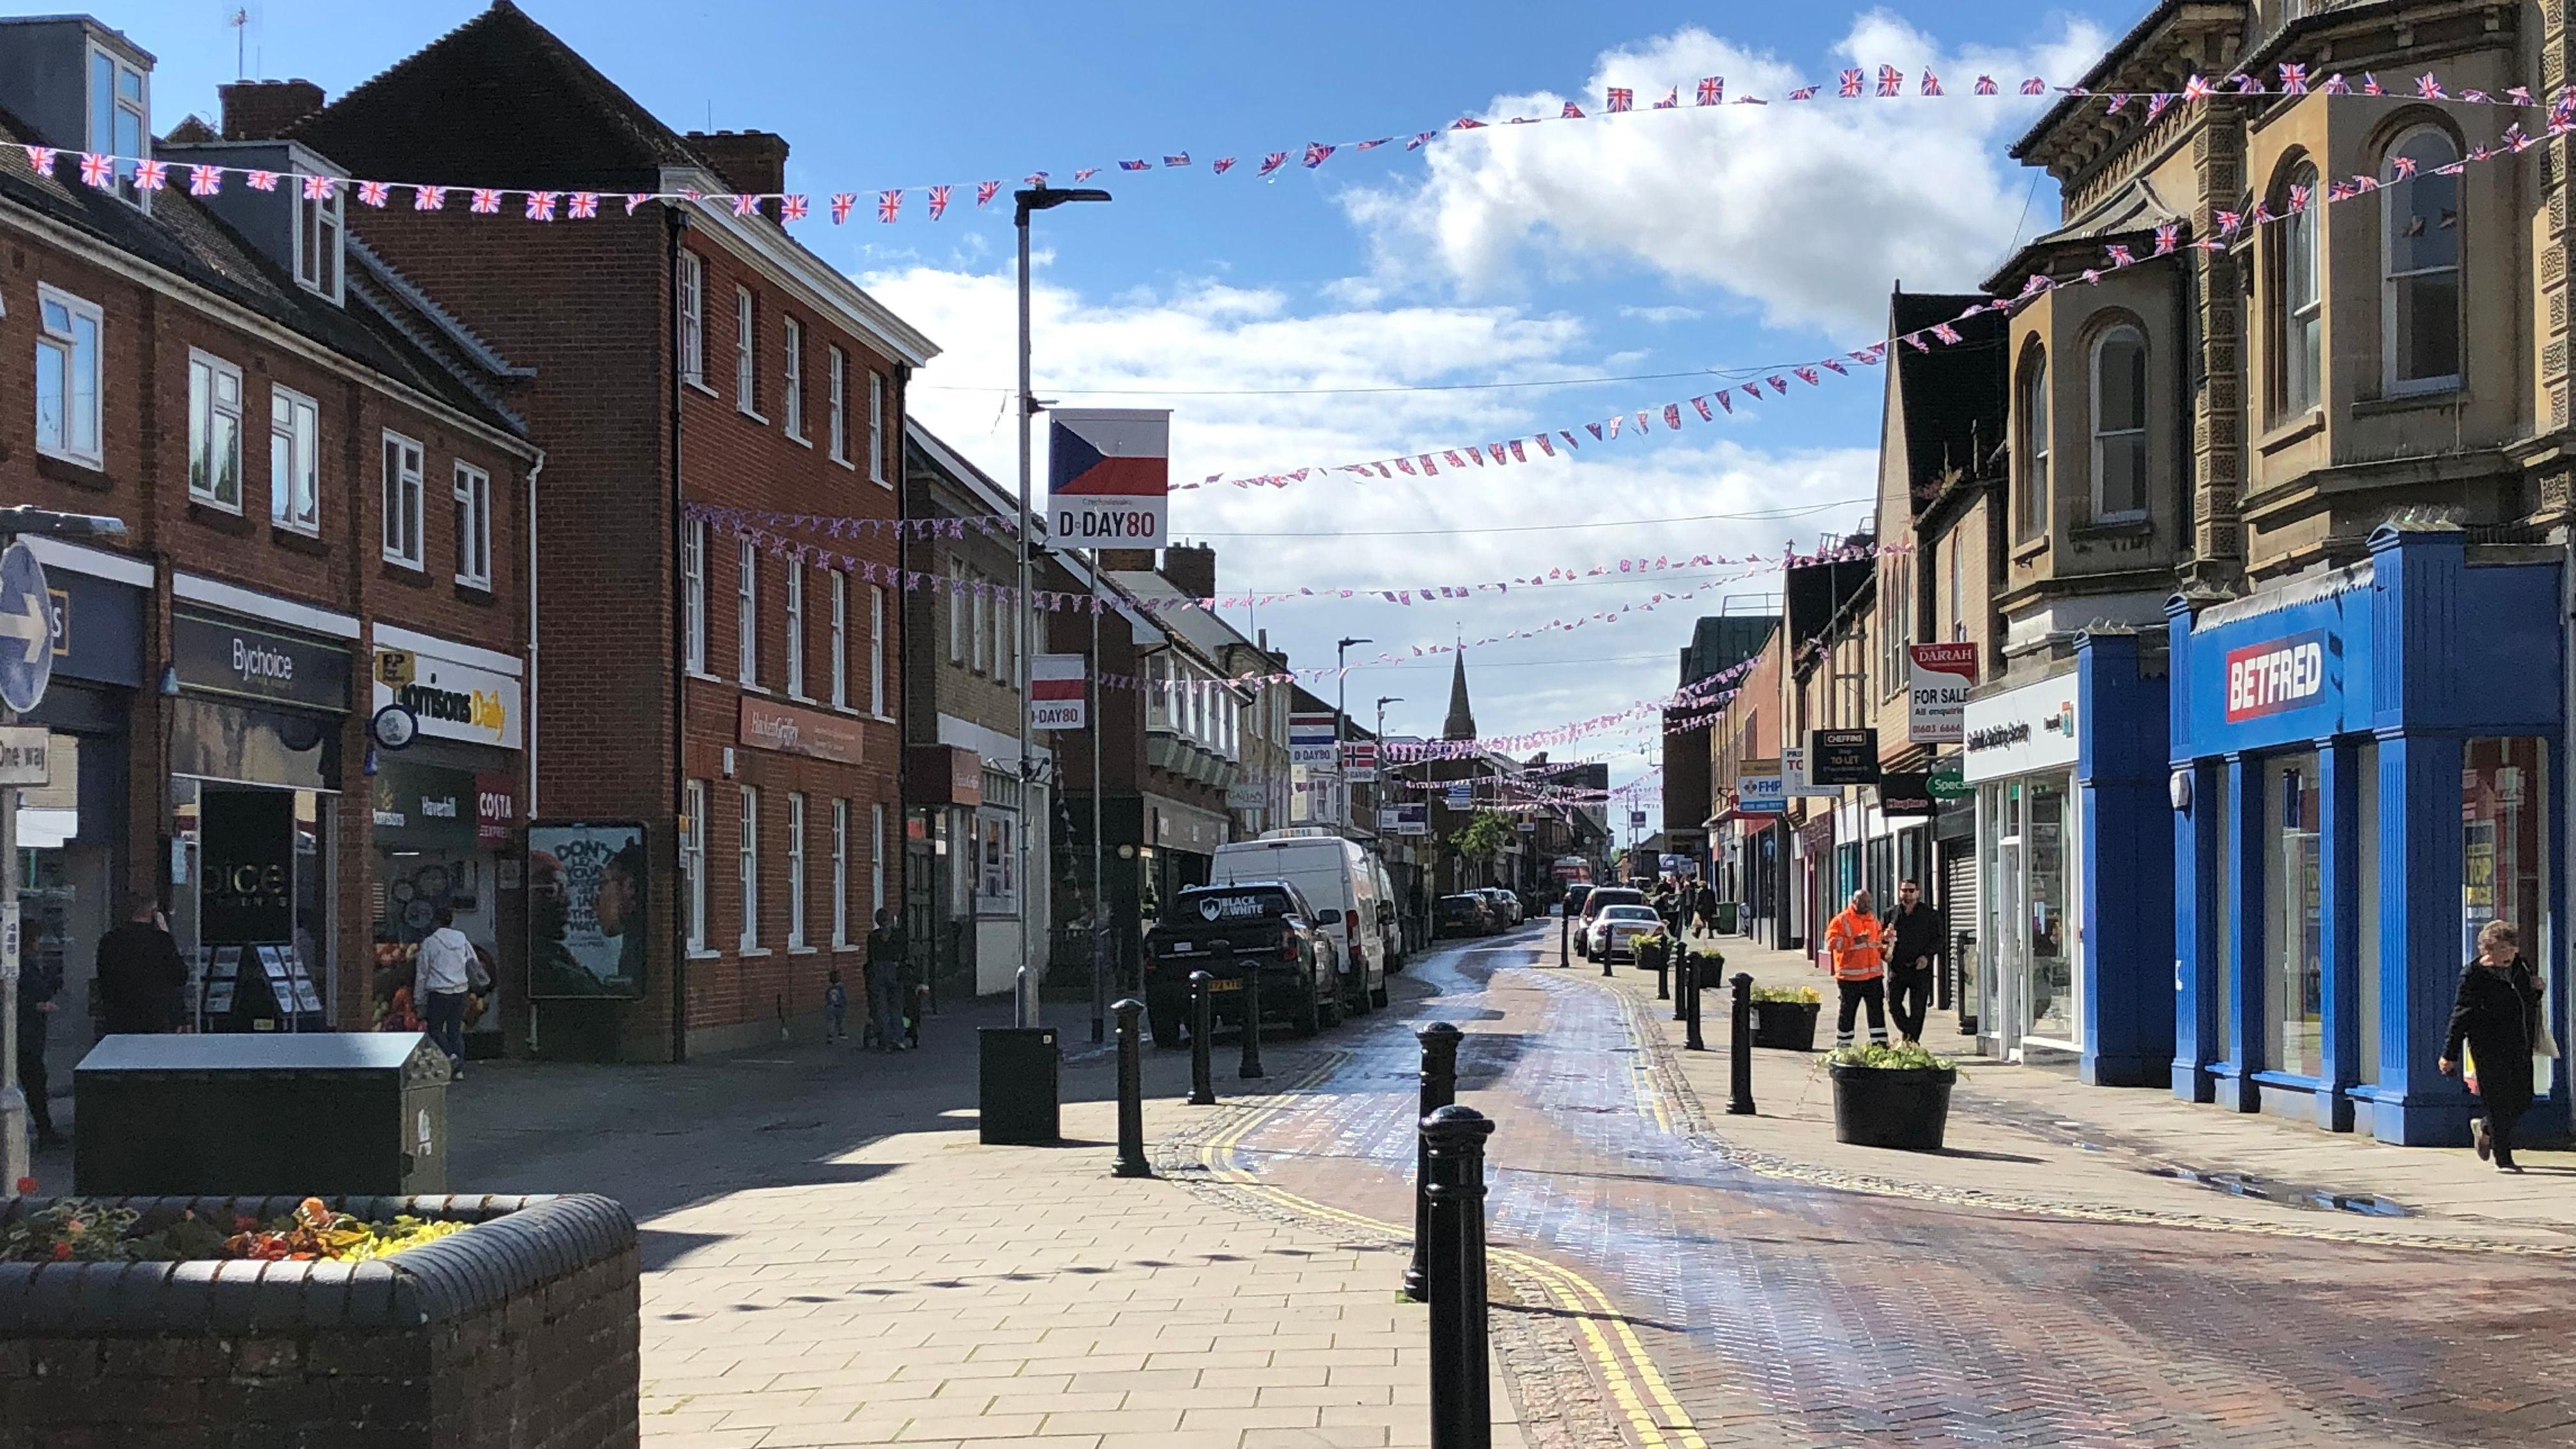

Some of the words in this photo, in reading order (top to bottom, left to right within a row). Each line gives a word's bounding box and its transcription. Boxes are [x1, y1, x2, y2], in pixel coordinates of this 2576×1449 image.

[233, 638, 292, 681] Bychoice
[1919, 648, 1972, 663] DARRAH
[2229, 642, 2321, 712] BETFRED
[1914, 689, 1937, 705] FOR
[472, 689, 505, 741] Daily
[1830, 756, 1843, 765] TO
[1844, 755, 1860, 765] LET
[1758, 780, 1781, 792] FHP
[480, 792, 512, 820] COSTA
[555, 840, 615, 864] DON'T
[2467, 857, 2492, 885] TOP
[1222, 896, 1256, 907] BLACK
[1230, 904, 1264, 916] WHITE
